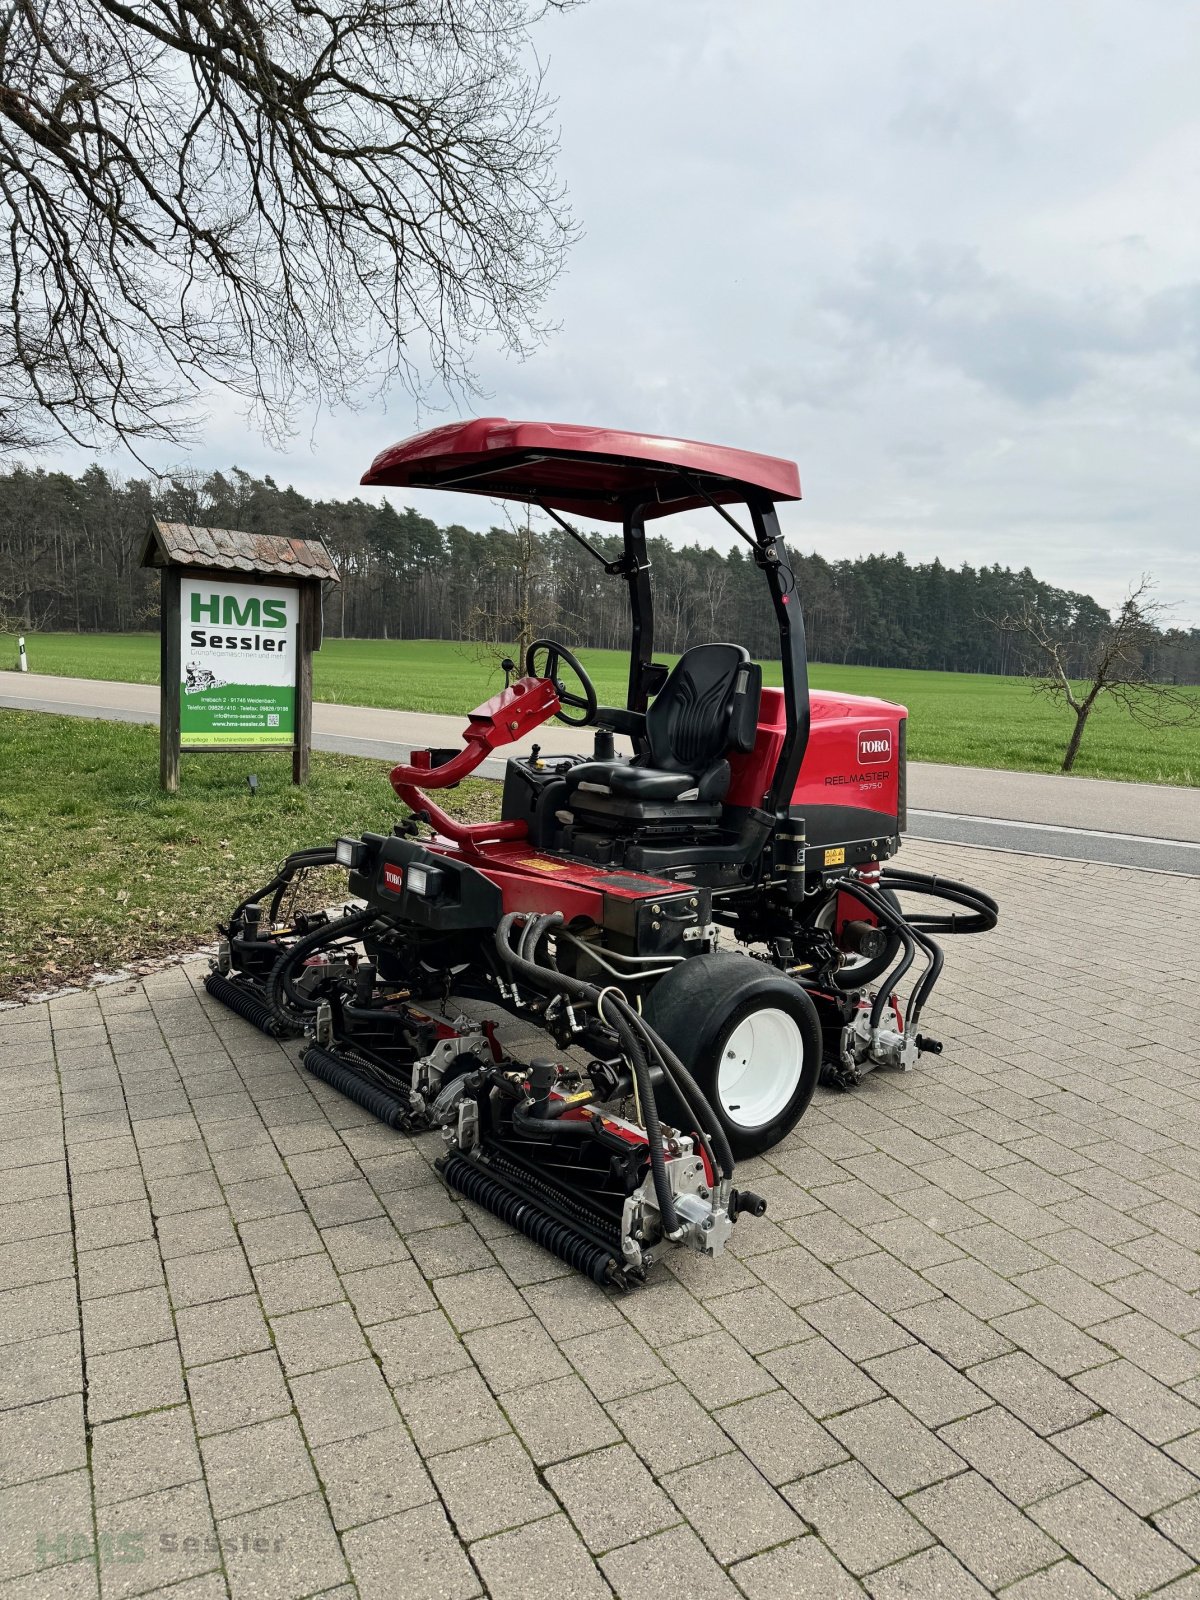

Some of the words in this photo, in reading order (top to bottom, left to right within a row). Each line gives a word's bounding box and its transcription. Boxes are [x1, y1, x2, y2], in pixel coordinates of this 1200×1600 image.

[190, 592, 287, 629] HMS
[190, 630, 287, 652] Sessler
[861, 739, 889, 754] TORO
[825, 771, 890, 786] REELMASTER
[385, 871, 402, 886] TORO
